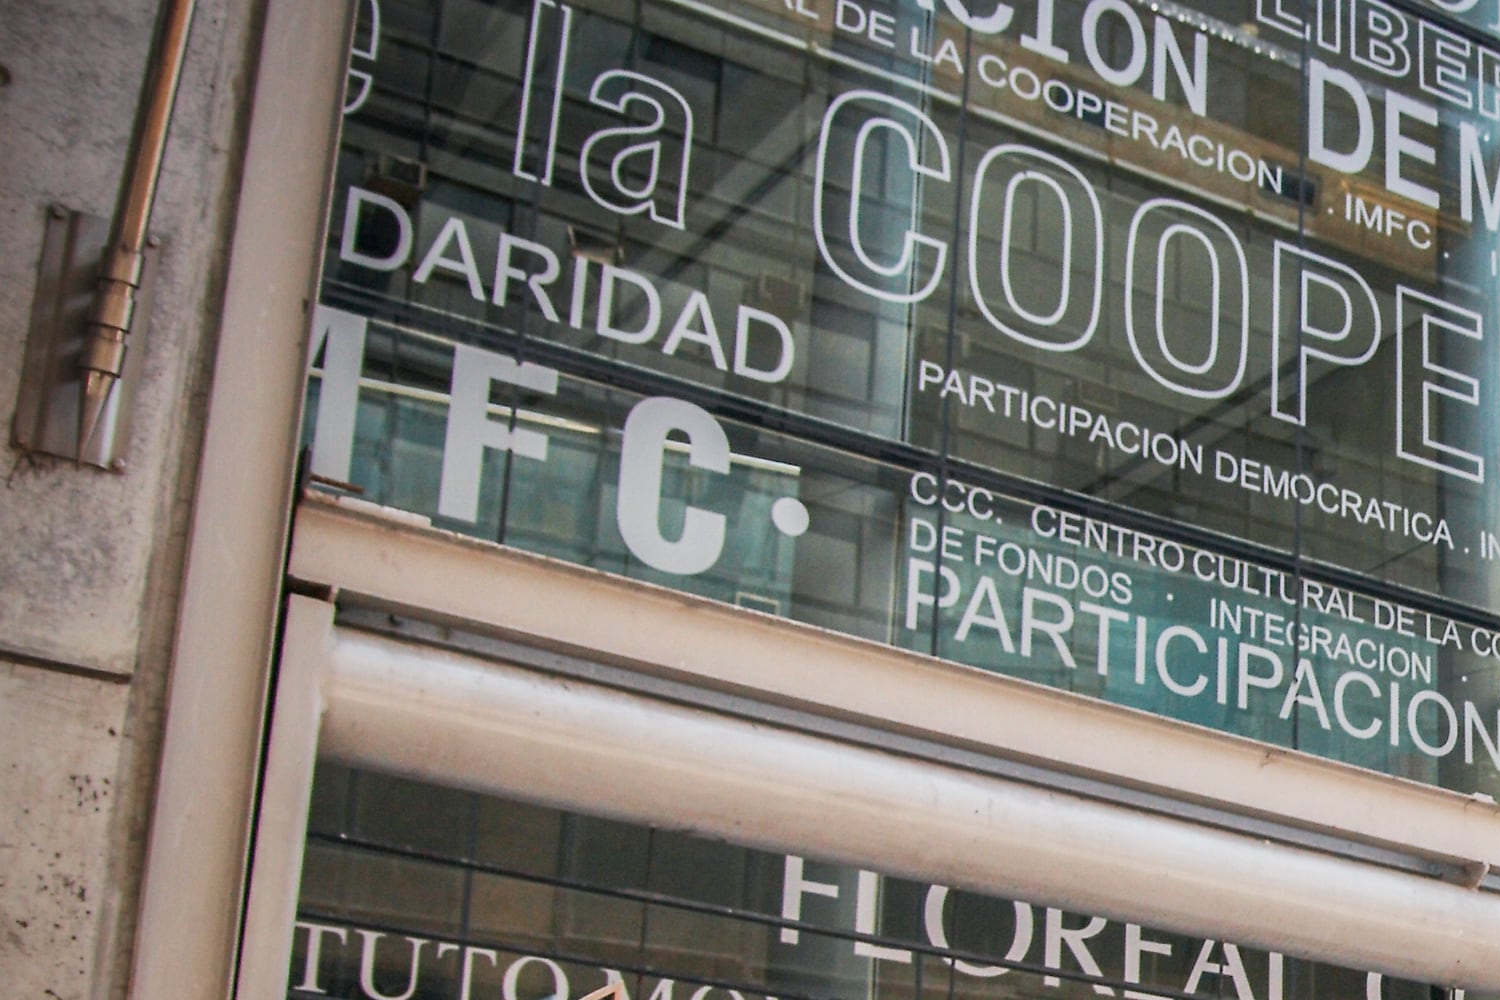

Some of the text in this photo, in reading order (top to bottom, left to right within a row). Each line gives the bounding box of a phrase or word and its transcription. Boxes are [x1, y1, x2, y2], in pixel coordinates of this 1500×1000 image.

[513, 0, 694, 230] la
[835, 0, 897, 48] DE
[911, 26, 965, 75] LA
[977, 55, 1283, 195] COOPERACION
[1344, 194, 1433, 250] IMFC
[918, 360, 1203, 474] PARTICIPACION
[1214, 450, 1454, 550] DEMOCRATICA
[910, 519, 965, 561] DE
[974, 537, 1133, 604] FONDOS
[1210, 599, 1432, 684] INTEGRACION
[1030, 504, 1185, 571] CENTRO
[1192, 551, 1365, 623] CULTURAL
[1373, 598, 1415, 637] DE
[1426, 613, 1462, 650] LA
